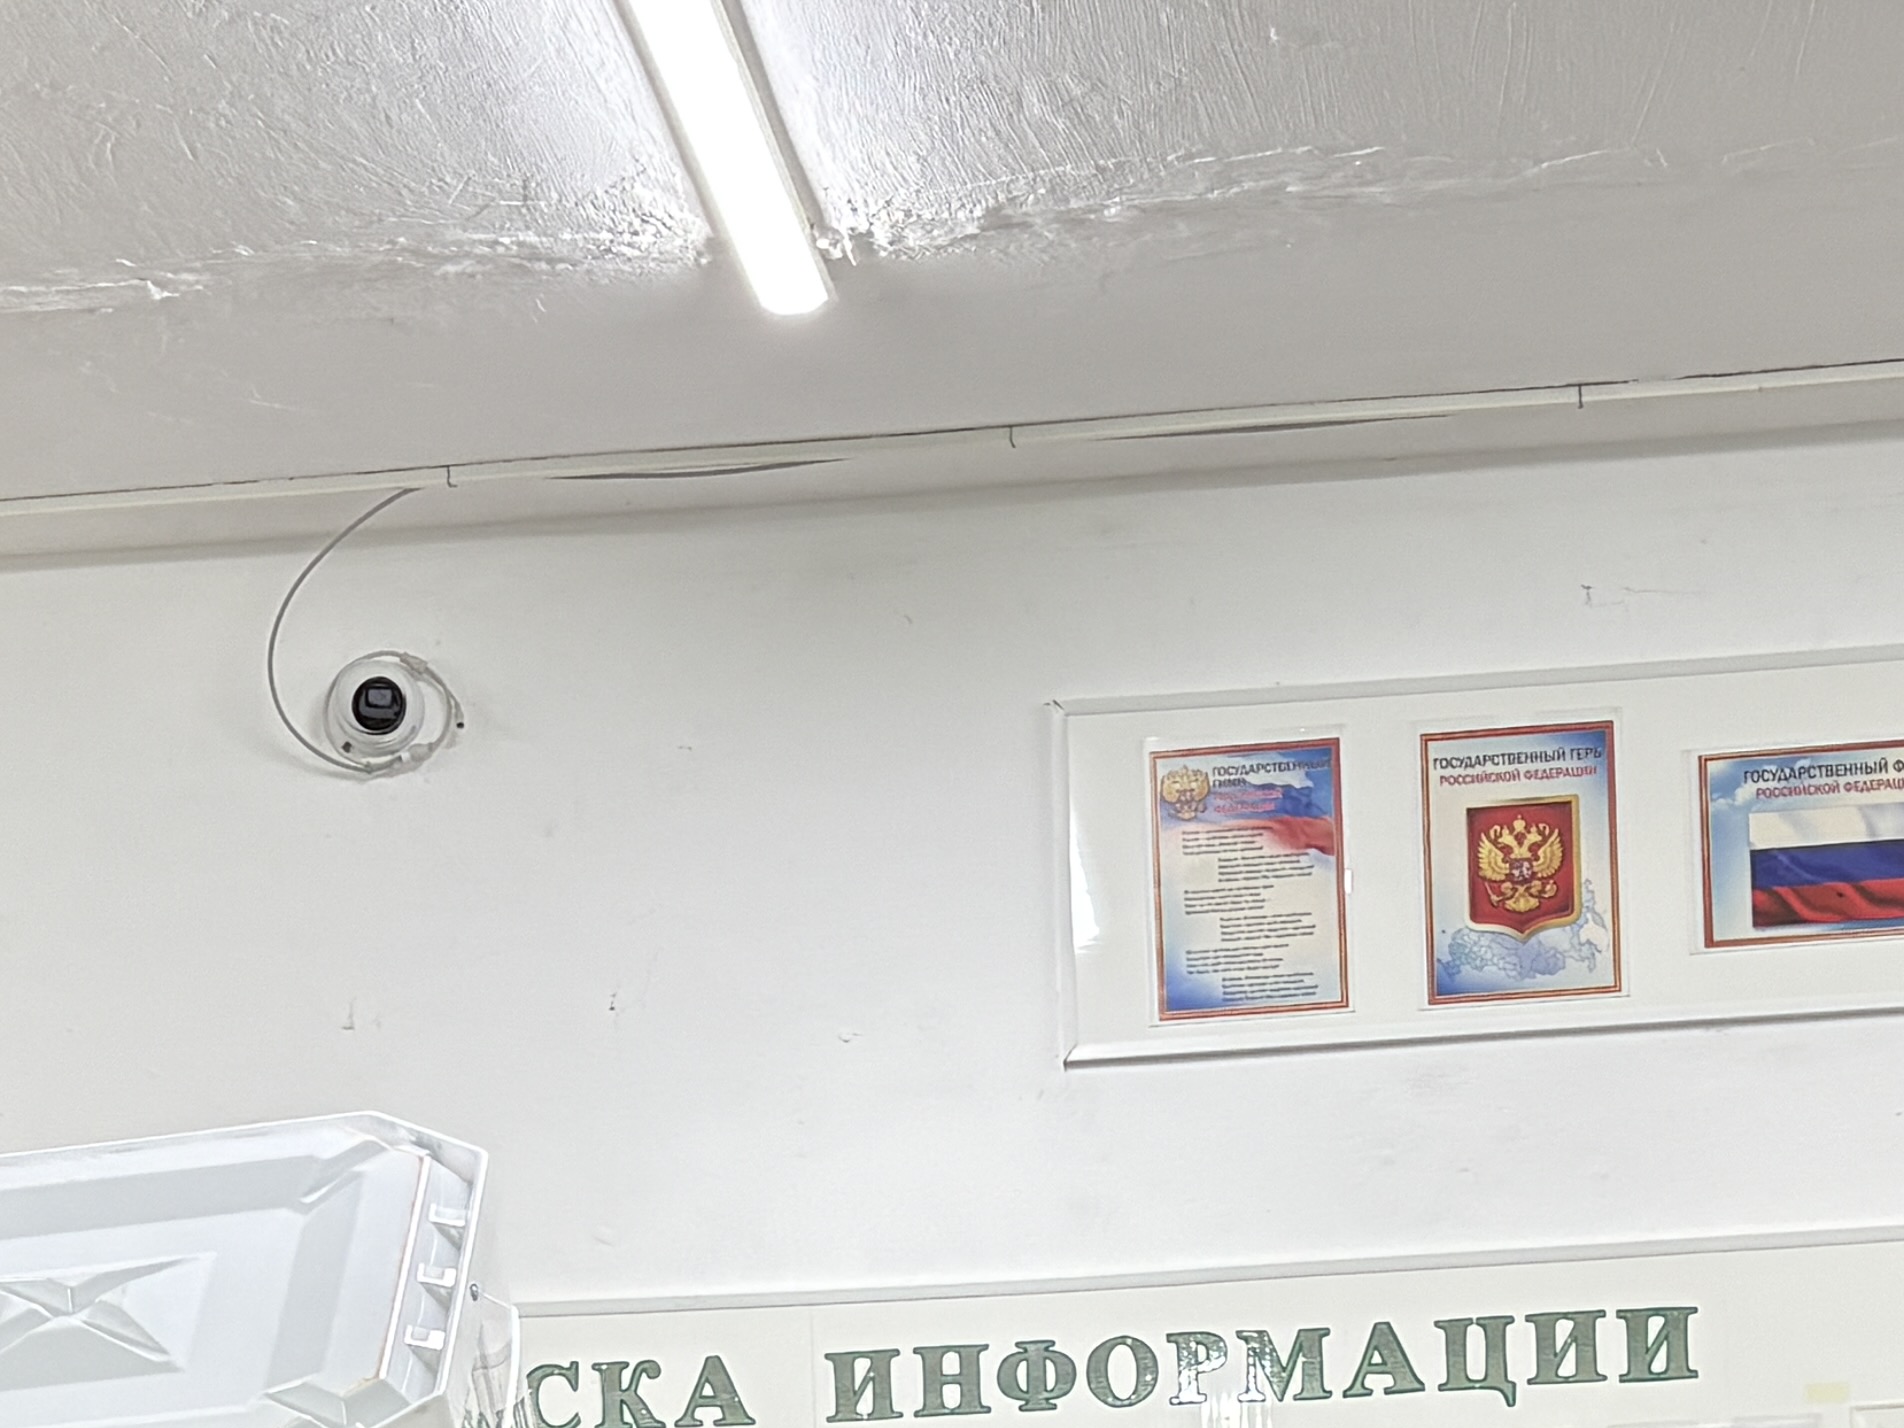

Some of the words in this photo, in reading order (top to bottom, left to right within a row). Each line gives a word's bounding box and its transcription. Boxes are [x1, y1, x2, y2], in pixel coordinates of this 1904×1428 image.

[1433, 747, 1566, 772] ГОСУДАРСТВЕННЫЙ
[1743, 757, 1888, 786] ГОСУДАРСТВЕННЫЙ
[824, 1306, 1700, 1424] ИНФОРМАЦИИ
